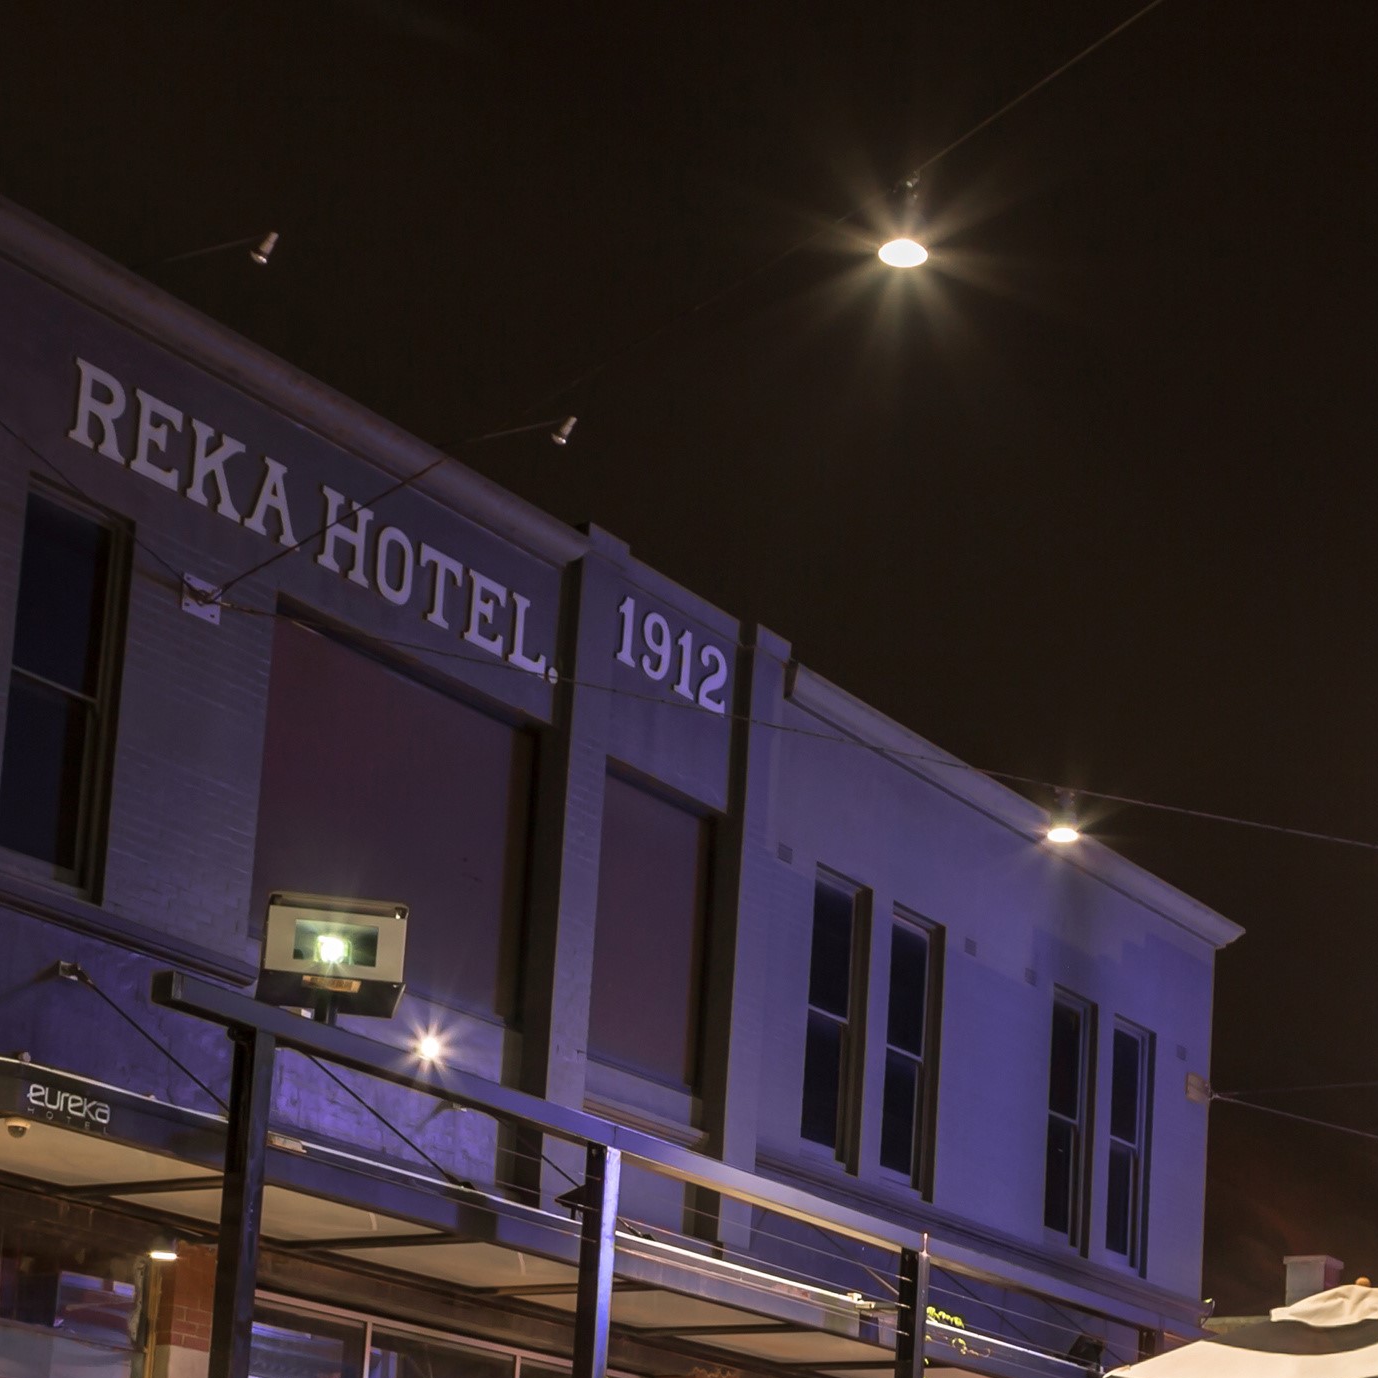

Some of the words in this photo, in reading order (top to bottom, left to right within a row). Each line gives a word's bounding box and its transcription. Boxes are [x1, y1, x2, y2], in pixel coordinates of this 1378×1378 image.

[67, 356, 301, 552] REKA
[615, 595, 728, 715] 1912
[26, 1083, 111, 1124] eureka
[27, 1106, 109, 1134] HOTEL
